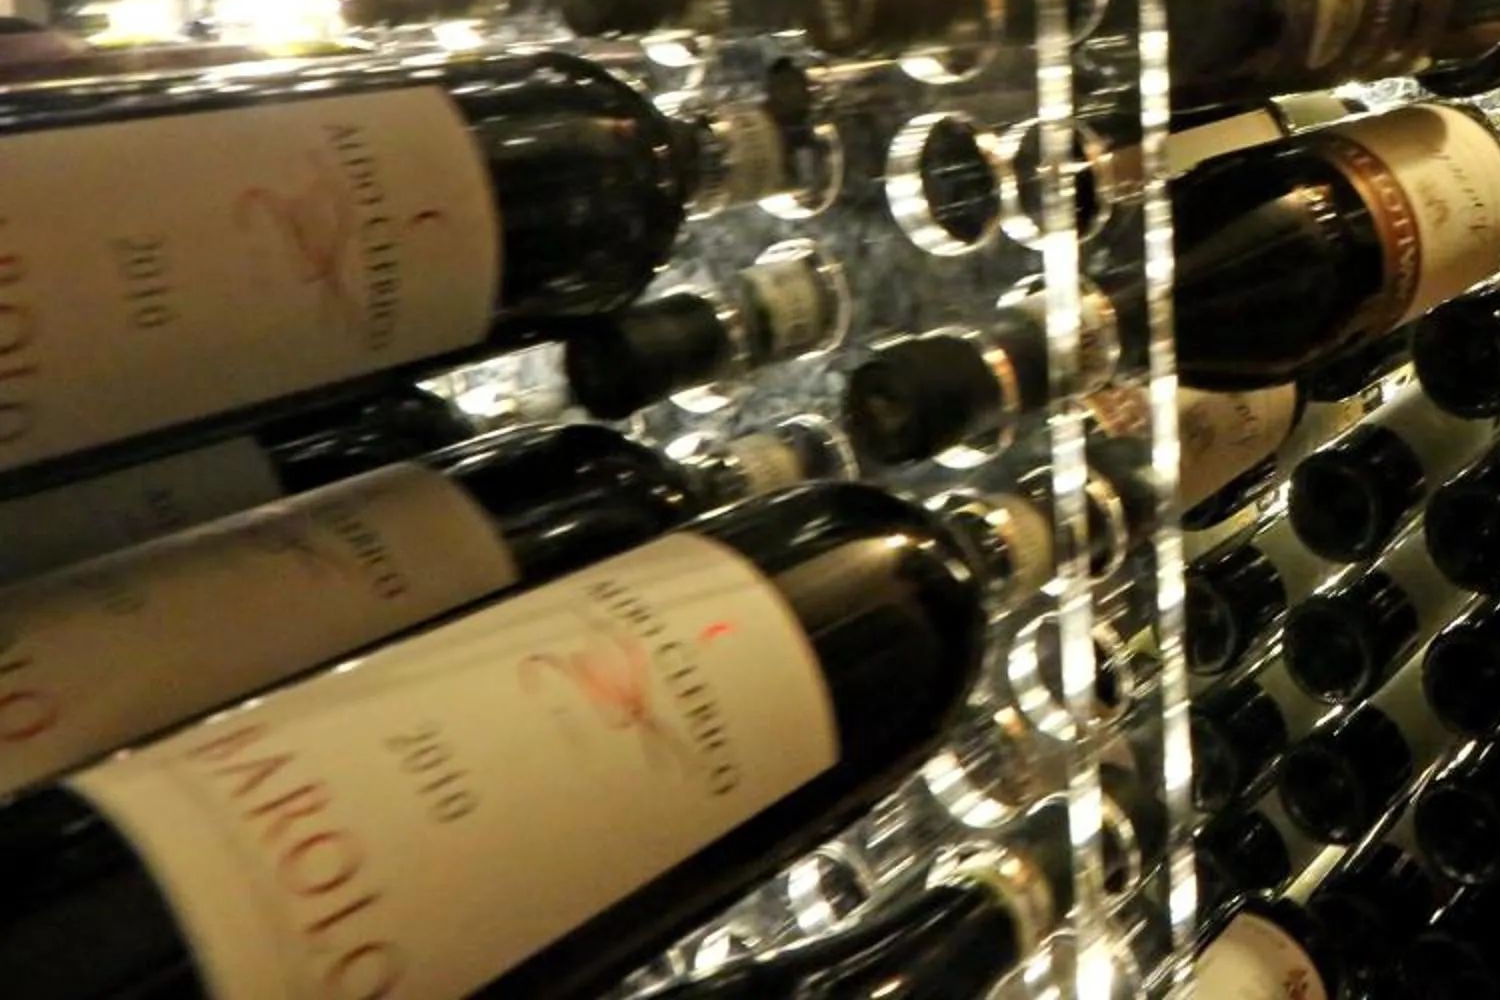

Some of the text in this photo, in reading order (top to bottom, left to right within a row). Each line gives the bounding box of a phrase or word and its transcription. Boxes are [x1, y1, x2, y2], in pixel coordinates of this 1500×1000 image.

[108, 236, 177, 328] 2010
[382, 726, 479, 825] 2010
[652, 639, 743, 798] CLERICO
[185, 720, 407, 1000] BAROLO
